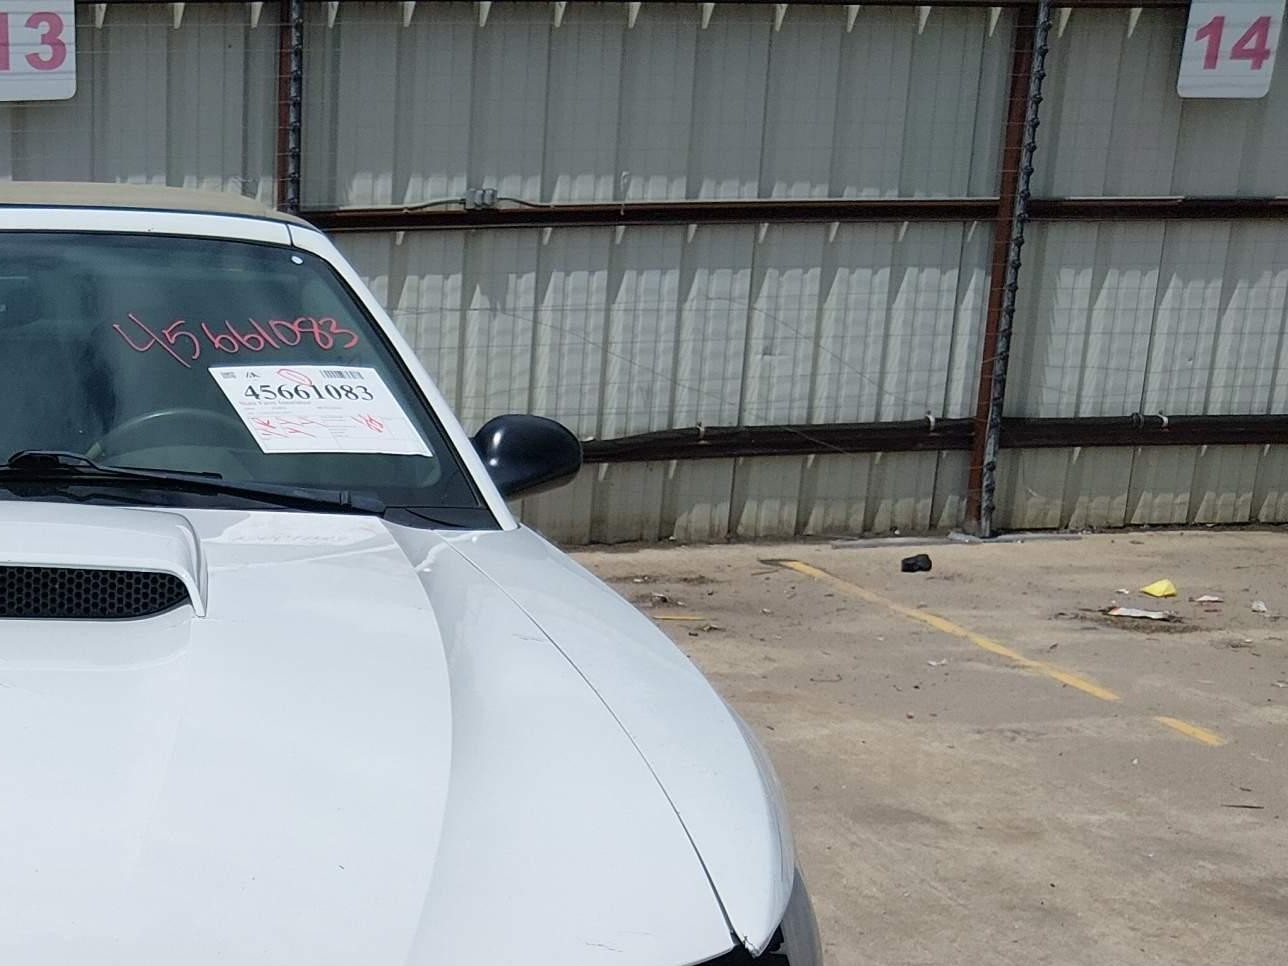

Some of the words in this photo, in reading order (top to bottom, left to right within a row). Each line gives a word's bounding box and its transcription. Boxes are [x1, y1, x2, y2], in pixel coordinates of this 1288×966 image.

[1194, 15, 1272, 71] 14
[112, 312, 360, 369] 45661083
[243, 383, 375, 402] 45661083
